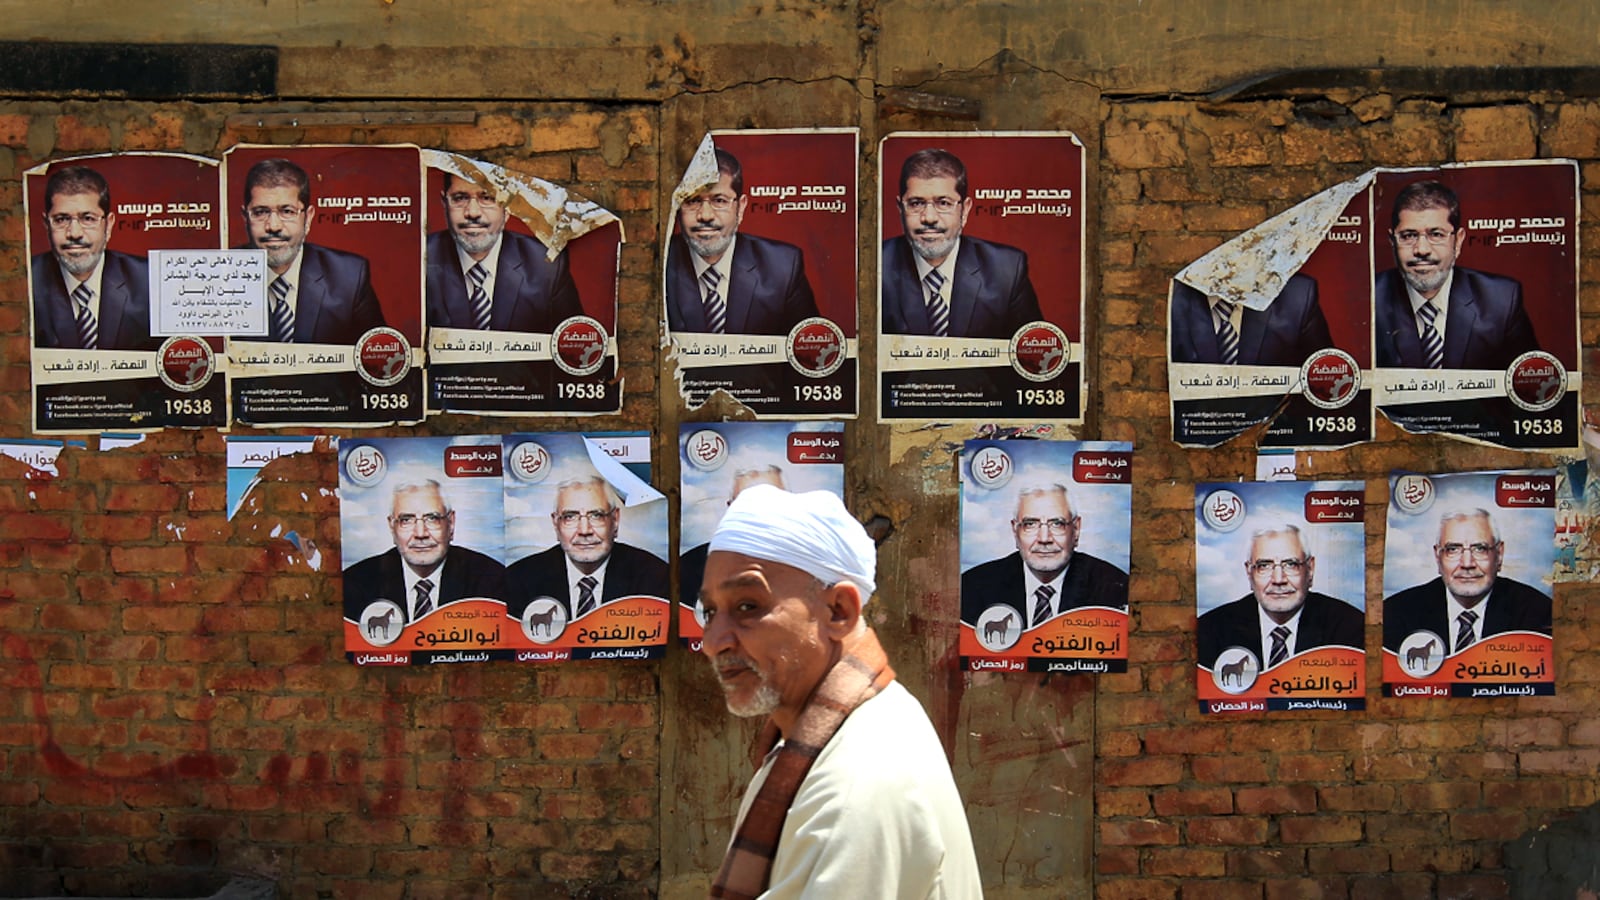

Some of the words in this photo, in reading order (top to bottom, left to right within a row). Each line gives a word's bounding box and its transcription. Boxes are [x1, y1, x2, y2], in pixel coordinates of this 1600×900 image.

[750, 185, 797, 199] مرسى
[801, 185, 846, 196] محمد
[975, 189, 1022, 203] مرسى
[1026, 189, 1072, 199] محمد
[317, 197, 363, 211] مرسى
[367, 196, 411, 207] محمد
[777, 200, 811, 214] لمصر
[117, 203, 163, 217] مرسى
[167, 202, 210, 213] محمد
[1001, 203, 1036, 217] لمصر
[343, 211, 377, 225] لمصر
[1334, 216, 1361, 226] مح
[1519, 217, 1565, 228] محمد
[144, 217, 177, 231] لمصر
[1468, 218, 1516, 233] مرسى
[1495, 232, 1530, 247] لمصر
[166, 256, 187, 267] الكرام
[235, 256, 258, 267] بشرى
[240, 271, 261, 282] يوجد
[243, 300, 252, 308] مع
[223, 310, 233, 318] ش
[433, 338, 466, 353] شعب
[469, 341, 492, 355] إرادة
[503, 341, 541, 352] النهضة
[677, 342, 700, 355] شع
[704, 344, 727, 358] إرادة
[738, 344, 777, 354] النهضة
[890, 345, 923, 360] شعب
[926, 347, 950, 361] إرادة
[961, 347, 1000, 358] النهضة
[238, 352, 270, 367] شعب
[273, 353, 297, 367] إرادة
[307, 353, 345, 364] النهضة
[43, 358, 74, 373] شعب
[76, 359, 100, 373] إرادة
[110, 359, 147, 370] النهضة
[1180, 373, 1213, 389] شعب
[1215, 376, 1240, 390] إرادة
[1251, 375, 1290, 386] النهضة
[1384, 378, 1417, 394] شعب
[1421, 379, 1445, 393] إرادة
[1456, 379, 1495, 390] النهضة
[557, 383, 605, 399] 19538
[793, 385, 843, 401] 19538
[361, 394, 409, 409] 19538
[1016, 389, 1065, 405] 19538
[164, 399, 212, 415] 19538
[1307, 416, 1357, 432] 19538
[1513, 419, 1563, 435] 19538
[793, 437, 821, 447] الوسط
[821, 437, 840, 447] حزب
[451, 452, 477, 461] الوسط
[478, 452, 497, 461] حزب
[1079, 457, 1108, 466] الوسط
[1108, 457, 1128, 467] حزب
[1502, 480, 1531, 491] الوسط
[1531, 481, 1551, 492] حزب
[1311, 497, 1340, 506] الوسط
[1340, 497, 1360, 506] حزب
[443, 609, 480, 620] المنعم
[482, 610, 499, 618] عبد
[606, 606, 643, 618] المنعم
[647, 607, 662, 616] عبد
[1062, 618, 1101, 628] المنعم
[1103, 619, 1121, 628] عبد
[414, 626, 473, 646] الفتوح
[476, 623, 500, 646] أبو
[577, 624, 635, 643] الفتوح
[637, 621, 661, 642] أبو
[1031, 634, 1092, 655] الفتوح
[1095, 633, 1120, 655] أبو
[1485, 642, 1524, 653] المنعم
[1526, 643, 1545, 653] عبد
[357, 652, 393, 665] الحصان
[393, 653, 408, 664] رمز
[430, 652, 460, 664] لمصر
[518, 650, 553, 661] الحصان
[555, 651, 569, 659] رمز
[590, 649, 619, 659] لمصر
[971, 659, 1008, 670] الحصان
[1009, 659, 1024, 670] رمز
[1047, 660, 1078, 672] لمصر
[1299, 657, 1337, 668] المنعم
[1339, 658, 1357, 667] عبد
[1454, 660, 1516, 679] الفتوح
[1519, 658, 1545, 679] أبو
[1269, 675, 1330, 694] الفتوح
[1333, 672, 1357, 694] أبو
[1394, 686, 1432, 697] الحصان
[1433, 687, 1448, 696] رمز
[1472, 685, 1504, 697] لمصر
[1211, 701, 1248, 713] الحصان
[1250, 702, 1264, 711] رمز
[1288, 700, 1318, 710] لمصر
